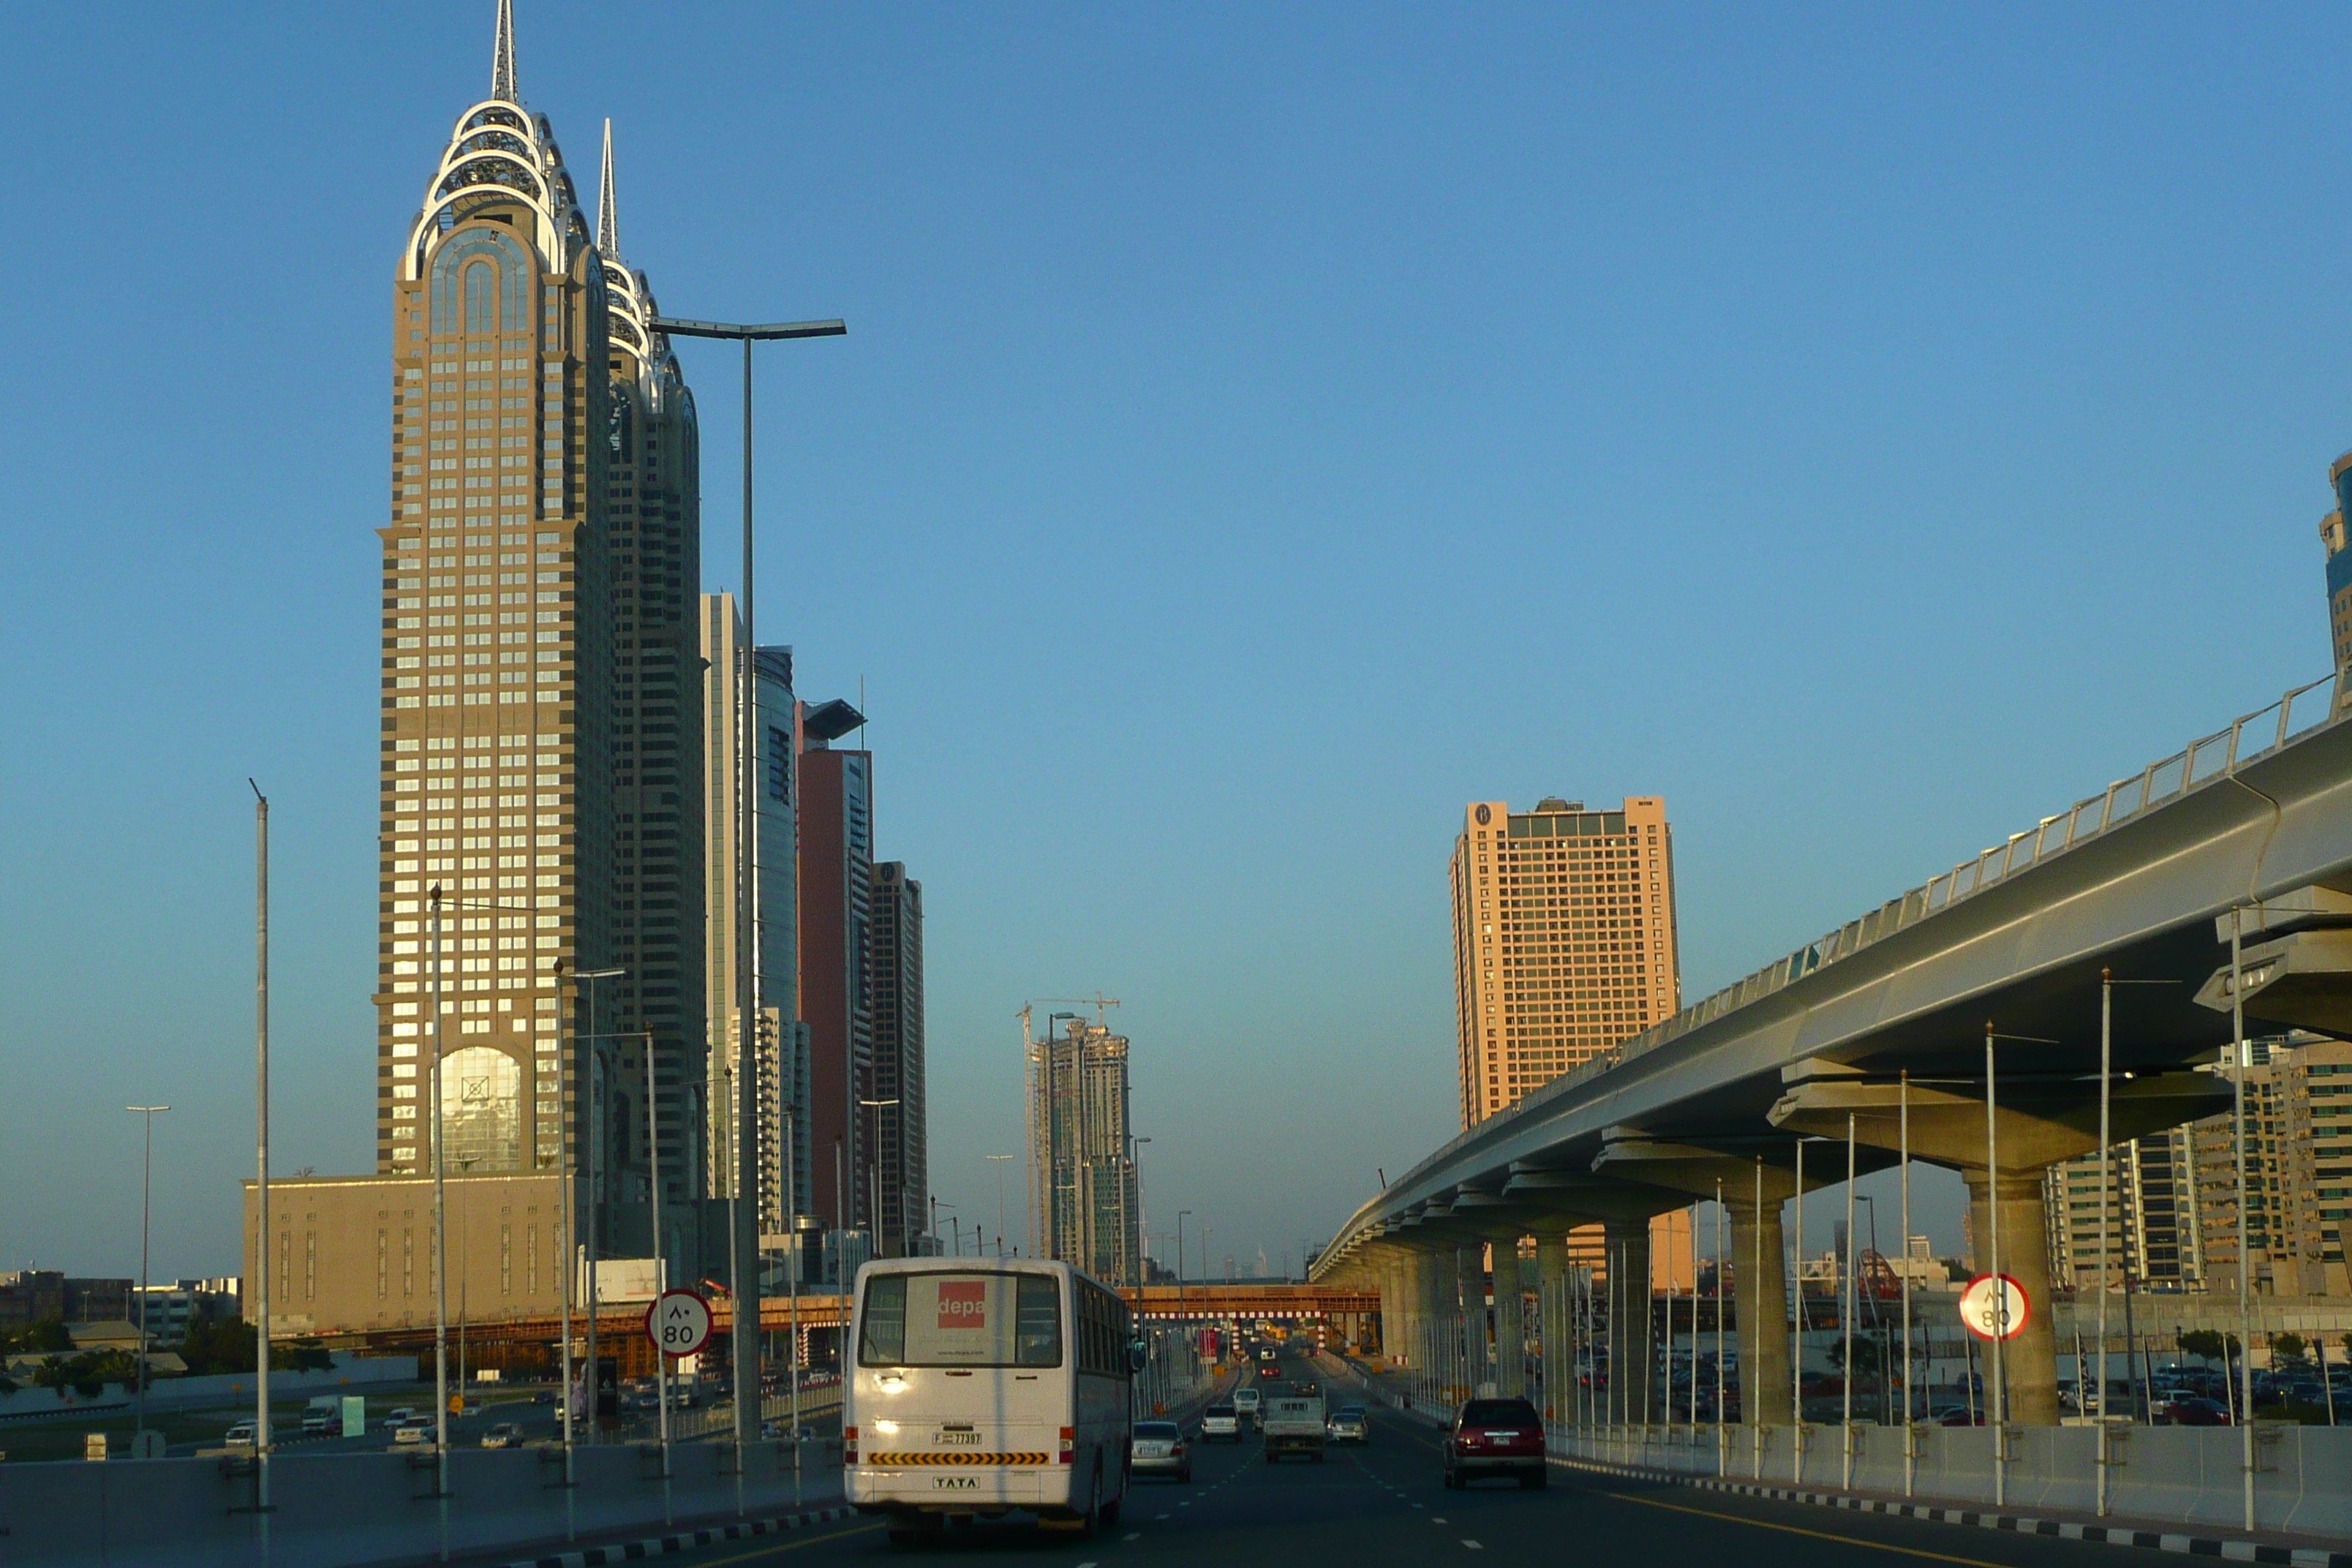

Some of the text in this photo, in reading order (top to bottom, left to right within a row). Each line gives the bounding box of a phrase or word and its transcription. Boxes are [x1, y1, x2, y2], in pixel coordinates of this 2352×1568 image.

[669, 1304, 690, 1319] ٨٠
[938, 1297, 985, 1317] depa
[1982, 1310, 2010, 1327] 80
[664, 1326, 693, 1343] 80
[956, 1433, 980, 1444] 77397
[936, 1479, 976, 1488] TATA
